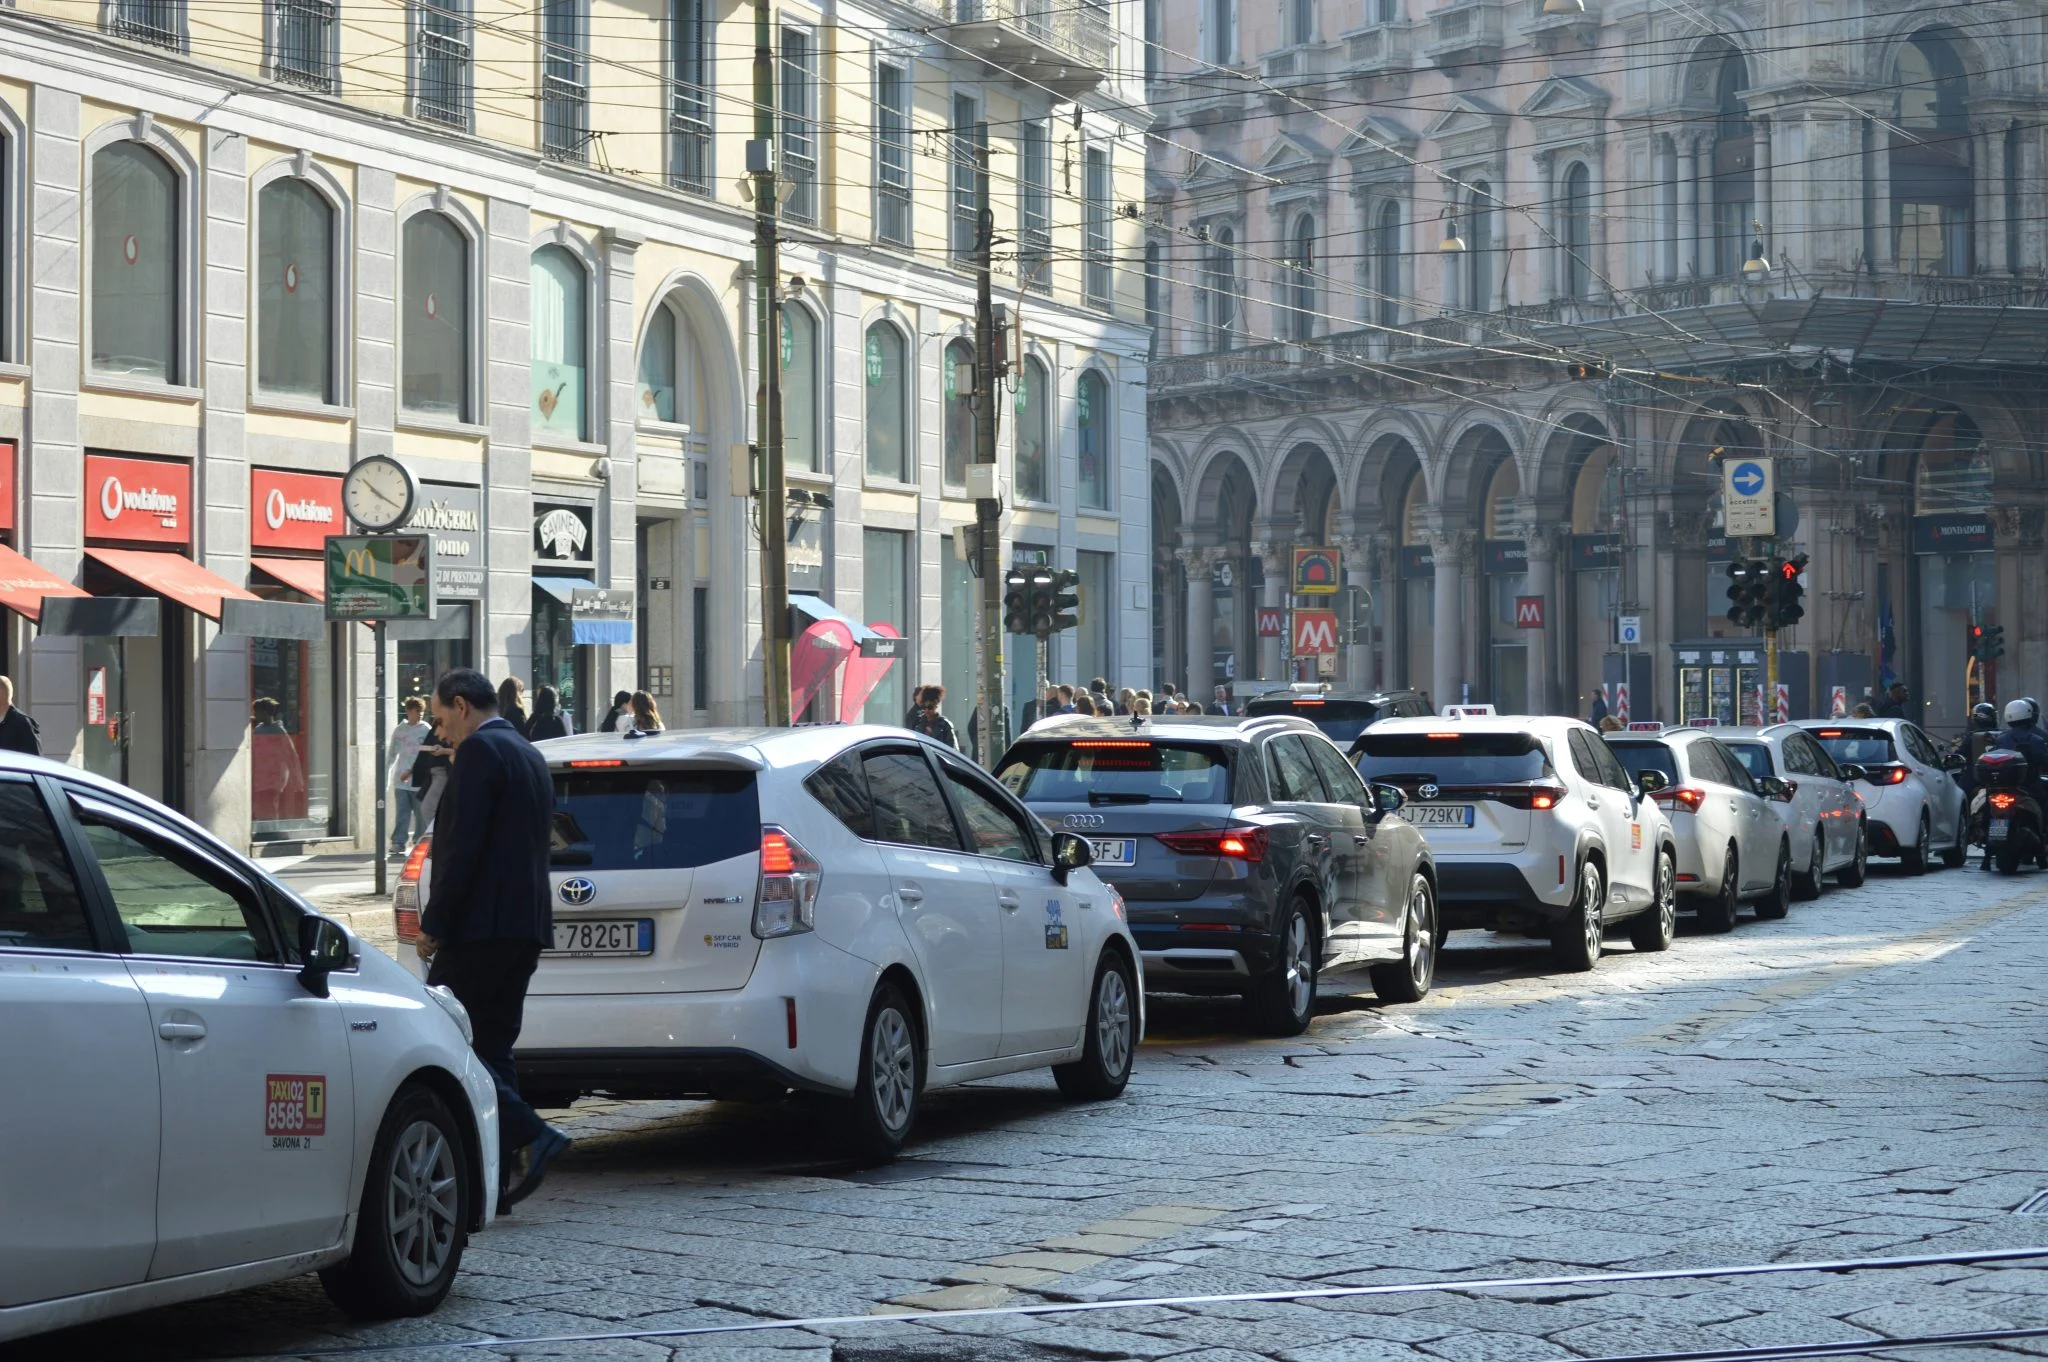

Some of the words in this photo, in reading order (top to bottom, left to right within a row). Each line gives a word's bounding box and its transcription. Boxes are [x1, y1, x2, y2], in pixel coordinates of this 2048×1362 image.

[123, 487, 177, 512] vodafone
[285, 499, 333, 523] vodafone
[408, 507, 479, 531] ROLOGERIA
[541, 511, 585, 548] SAVINELLI
[1941, 525, 1986, 535] MONDADORI
[451, 571, 484, 584] PRESTIGIO
[656, 581, 665, 589] 2
[1519, 604, 1541, 622] M
[1260, 614, 1281, 632] M
[1297, 620, 1335, 648] M
[1631, 722, 1661, 732] TAXI
[1419, 807, 1464, 824] 729KV
[566, 923, 635, 949] 782GT
[268, 1102, 304, 1129] 8585
[272, 1137, 301, 1150] SAVONA
